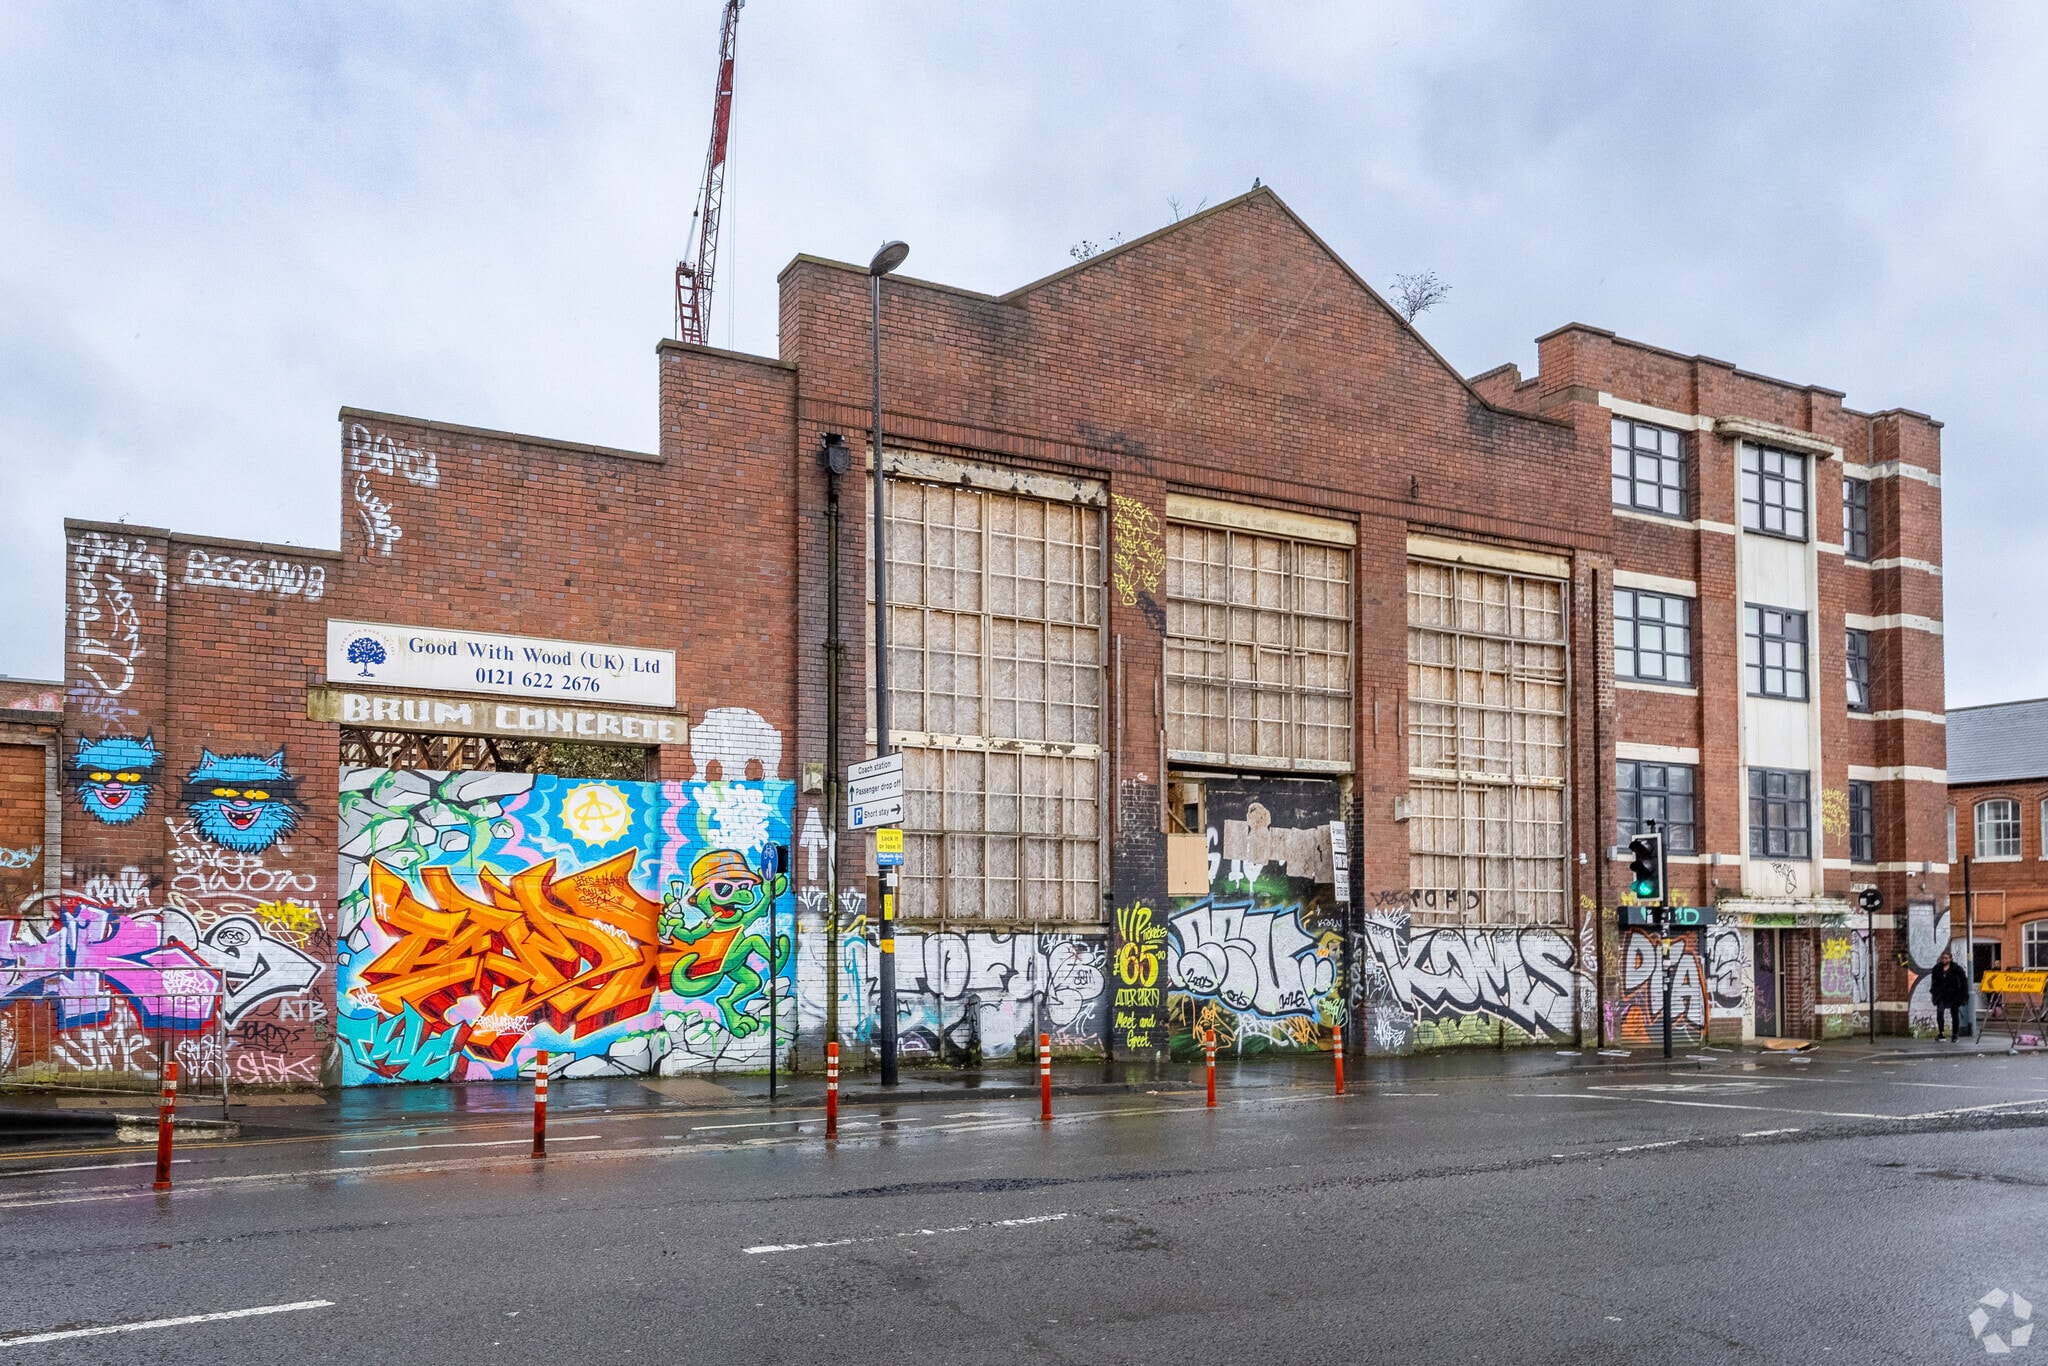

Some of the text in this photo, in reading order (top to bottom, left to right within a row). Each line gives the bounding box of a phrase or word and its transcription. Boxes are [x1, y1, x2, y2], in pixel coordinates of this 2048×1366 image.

[408, 637, 458, 656] Good
[467, 642, 514, 661] With
[523, 647, 572, 666] Wood
[581, 651, 625, 671] (UK)
[633, 657, 660, 674] Ltd
[475, 667, 600, 693] 0121 622 2676
[343, 693, 676, 742] BRUM CONCRETE
[858, 761, 891, 775] Coach station
[855, 779, 902, 796] Passenger drop off
[864, 810, 878, 819] Short
[878, 808, 890, 817] stay
[1117, 901, 1152, 943] VIP
[1114, 1011, 1156, 1029] Meet and
